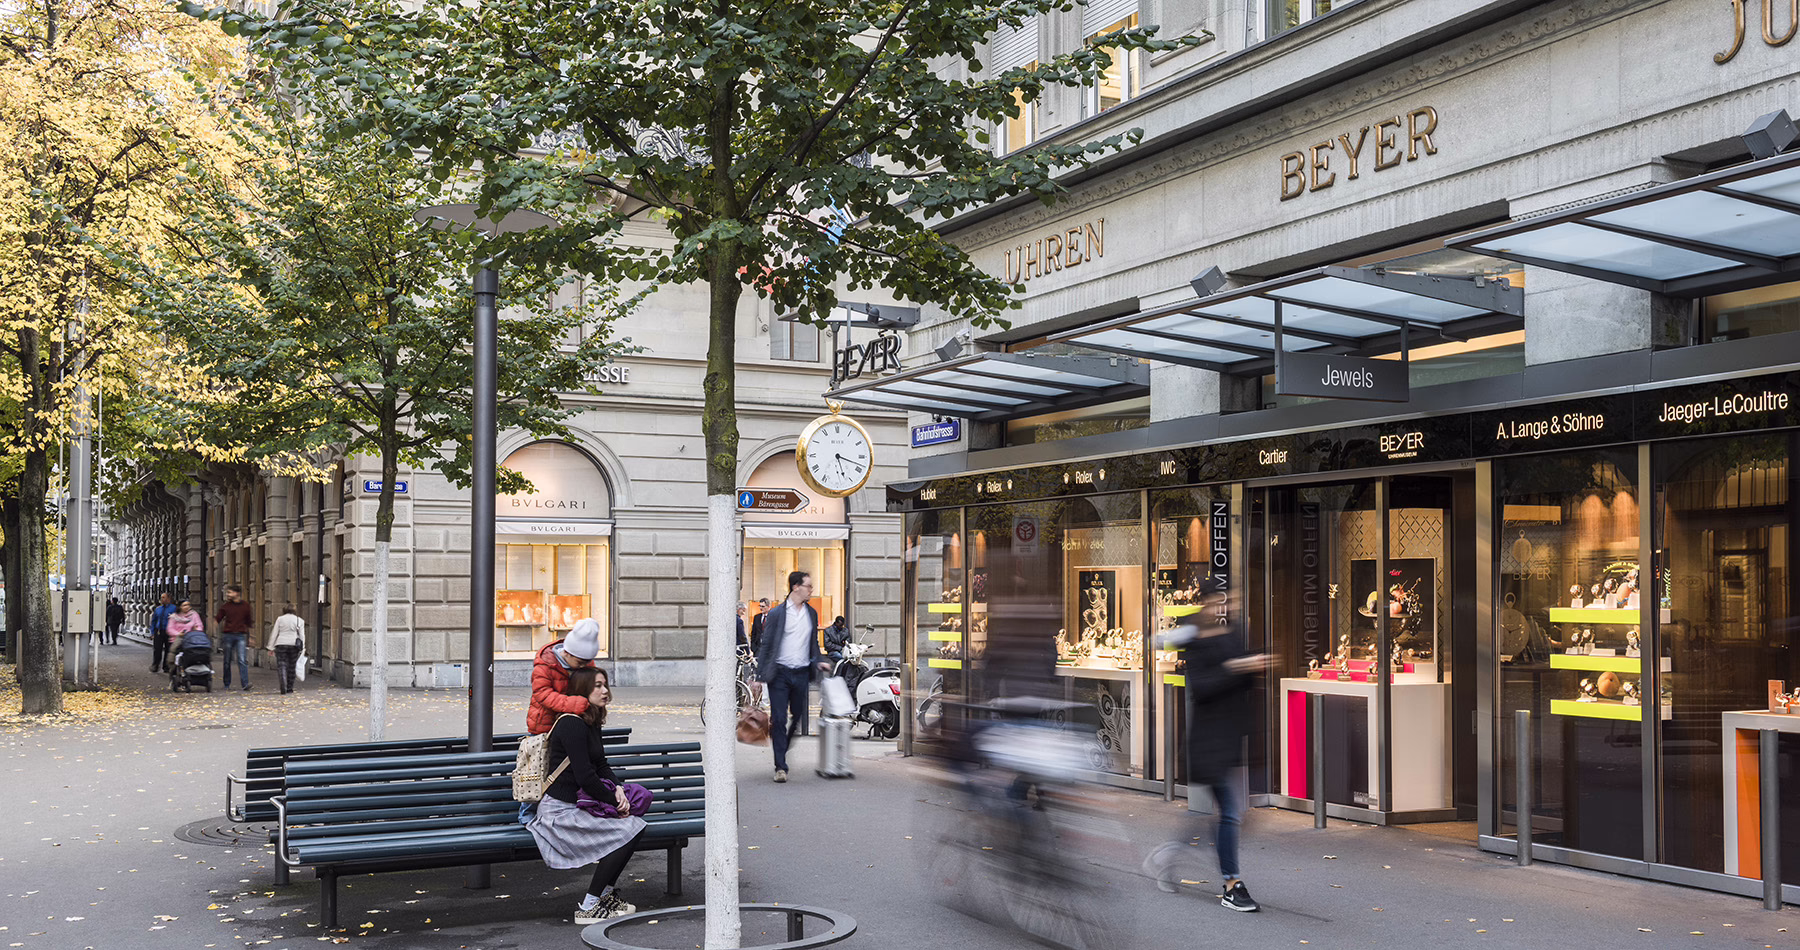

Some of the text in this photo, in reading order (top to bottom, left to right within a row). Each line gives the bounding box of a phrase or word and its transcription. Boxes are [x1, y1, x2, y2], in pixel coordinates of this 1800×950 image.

[1004, 218, 1104, 285] UHREN
[1280, 106, 1438, 201] BEYER
[835, 334, 902, 381] BEYER
[1321, 364, 1374, 389] Jewels
[1658, 390, 1789, 424] Jaeger-LeCoultre
[916, 426, 954, 442] Bahnhofstrasse
[1496, 412, 1604, 440] A. Lange & Söhne
[1380, 431, 1425, 453] BEYER
[1259, 448, 1288, 465] Cartier
[1160, 460, 1176, 475] IWC
[1075, 470, 1093, 484] Rolex
[920, 488, 937, 501] Hublot
[986, 480, 1003, 493] Rolex
[511, 498, 586, 509] BVLGARI
[761, 491, 786, 500] Museum
[1213, 502, 1228, 627] SEUM OFFEN
